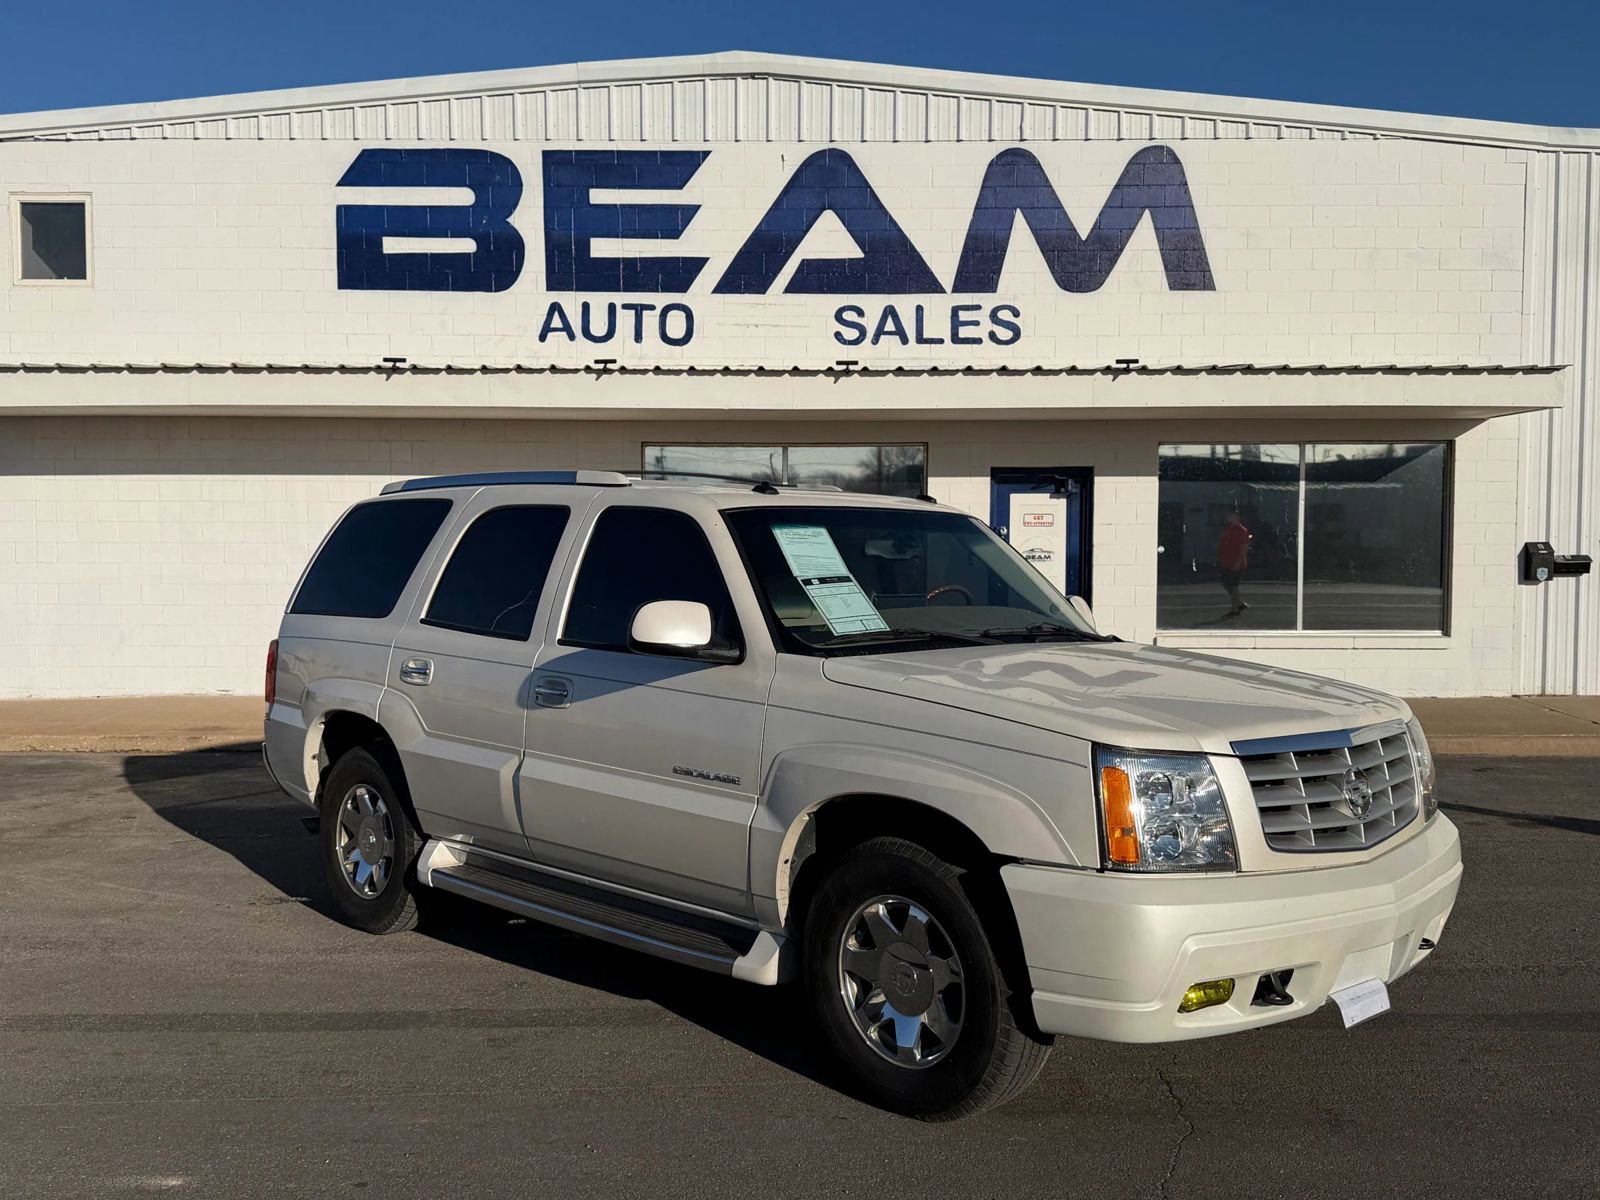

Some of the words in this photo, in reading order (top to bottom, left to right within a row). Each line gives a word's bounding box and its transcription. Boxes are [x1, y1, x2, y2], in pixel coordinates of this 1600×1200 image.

[336, 145, 1217, 294] BEAM
[538, 301, 695, 347] AUTO
[833, 303, 1022, 346] SALES
